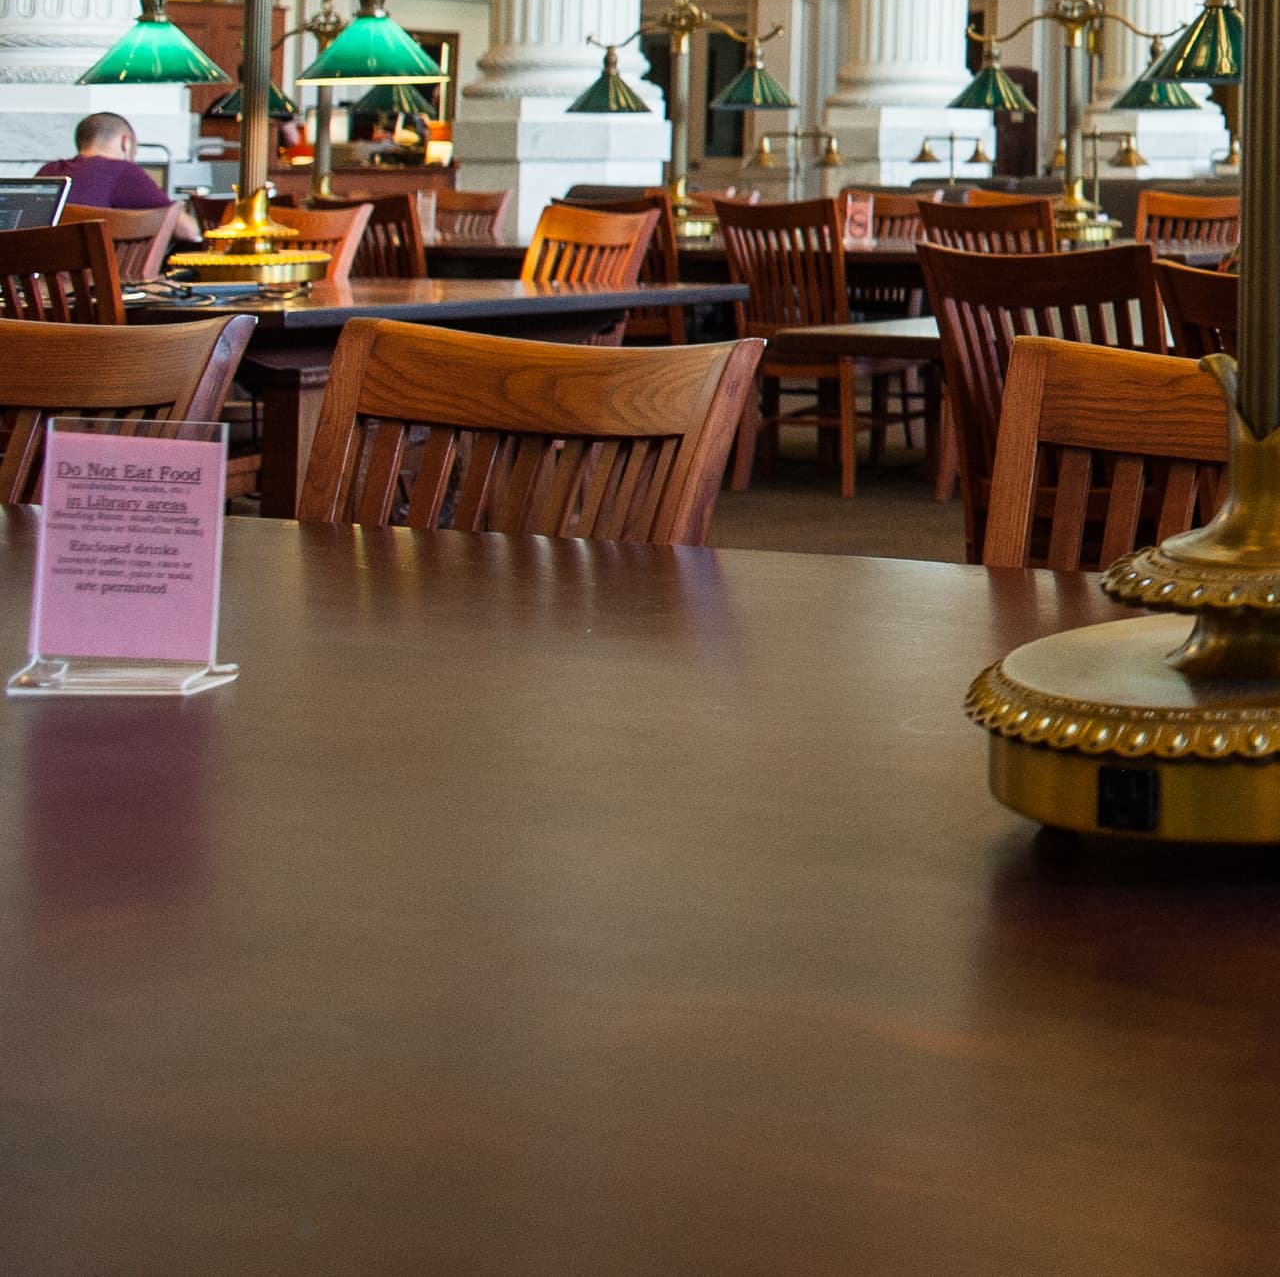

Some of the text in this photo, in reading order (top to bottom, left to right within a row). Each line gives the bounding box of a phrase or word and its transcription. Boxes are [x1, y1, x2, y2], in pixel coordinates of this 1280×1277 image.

[56, 461, 202, 481] Do Not Eat Food
[87, 495, 143, 511] Library
[146, 499, 188, 512] areas
[69, 539, 179, 556] Enclosed drinks
[101, 583, 168, 596] permitted
